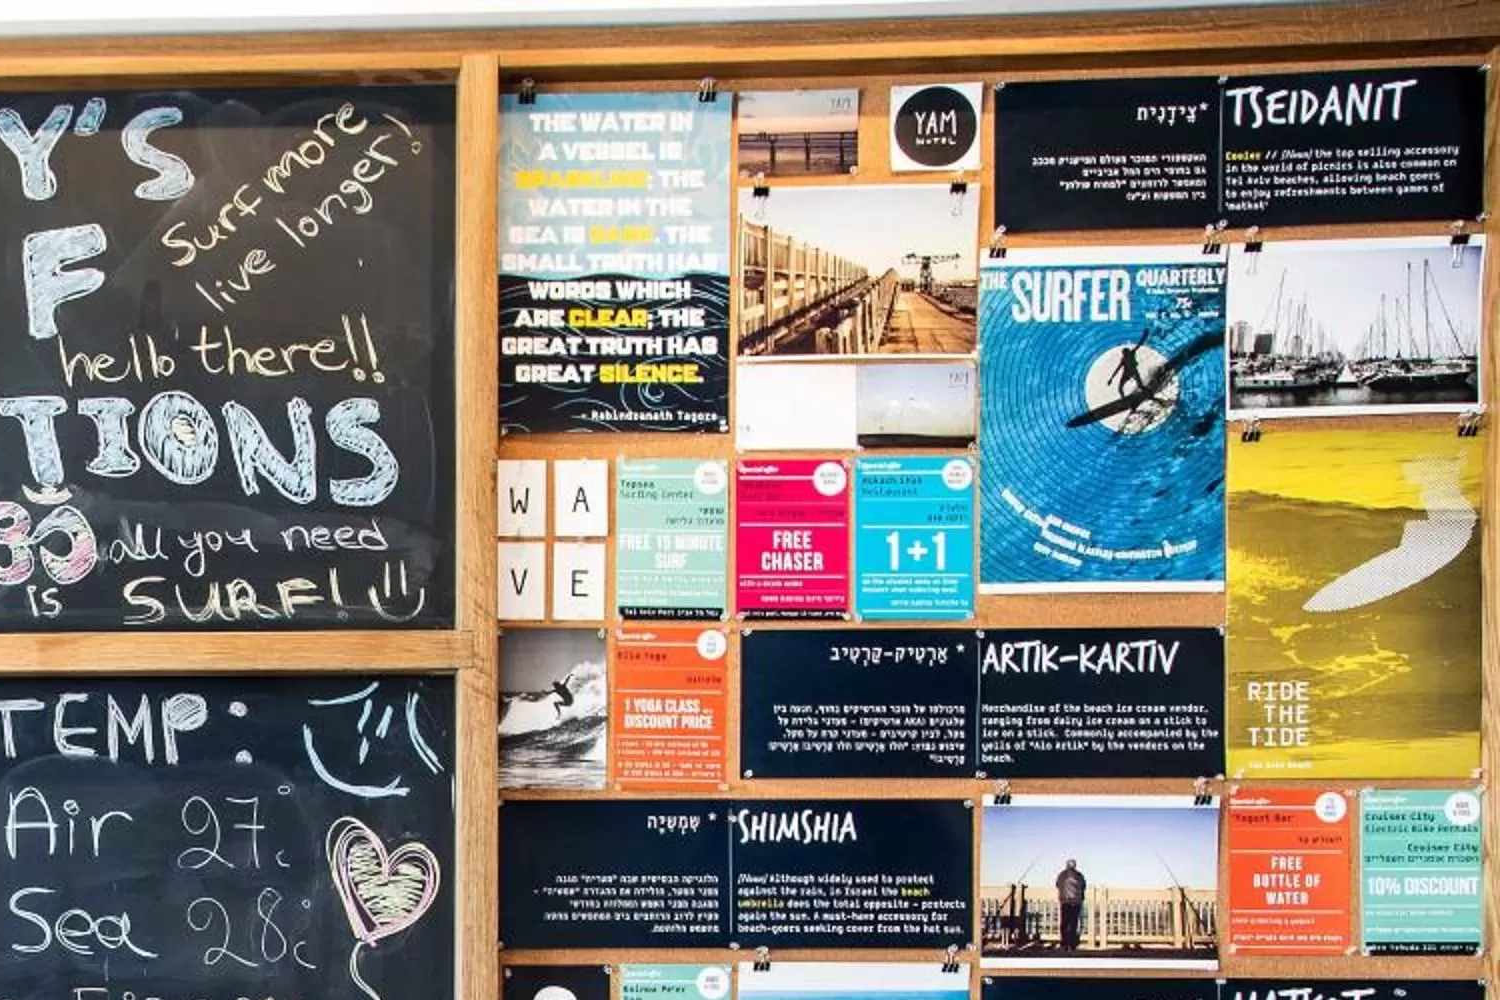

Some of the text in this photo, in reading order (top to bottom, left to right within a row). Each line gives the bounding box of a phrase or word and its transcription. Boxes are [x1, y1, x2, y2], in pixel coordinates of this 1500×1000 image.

[1226, 79, 1418, 128] TSEIDANIT
[529, 111, 694, 132] THE WATER IN
[914, 109, 956, 138] YAM
[538, 140, 682, 161] A VESSEL IS
[161, 102, 369, 267] Surf more
[658, 169, 705, 188] THE
[528, 198, 693, 216] WATER IN THE
[509, 225, 558, 244] SEA
[564, 225, 585, 243] IS
[665, 225, 712, 244] THE
[502, 253, 717, 272] SMALL TRUTH HAS
[196, 248, 276, 312] live
[528, 281, 691, 300] WORDS WHICH
[1011, 269, 1131, 323] SURFER
[1136, 267, 1225, 286] QUARTERLY
[514, 308, 705, 330] ARE CLEAR; THE
[58, 313, 386, 388] hello there!!
[502, 336, 718, 355] GREAT TRUTH HAS
[515, 364, 704, 384] GREAT SILENCE.
[178, 526, 259, 577] you
[280, 520, 390, 553] need
[772, 530, 813, 550] FREE
[761, 552, 824, 572] CHASER
[982, 640, 1180, 675] ARTIK-KARTIV
[1248, 681, 1311, 701] RIDE
[1264, 704, 1310, 724] THE
[1247, 727, 1310, 747] TIDE
[4, 786, 133, 859] Air
[738, 809, 857, 844] SHIMSHIA
[1271, 856, 1303, 870] FREE
[1253, 873, 1321, 888] BOTTLE OF
[1367, 876, 1480, 896] 10% DISCOUNT
[1265, 891, 1309, 905] WATER
[9, 886, 159, 958] Sea
